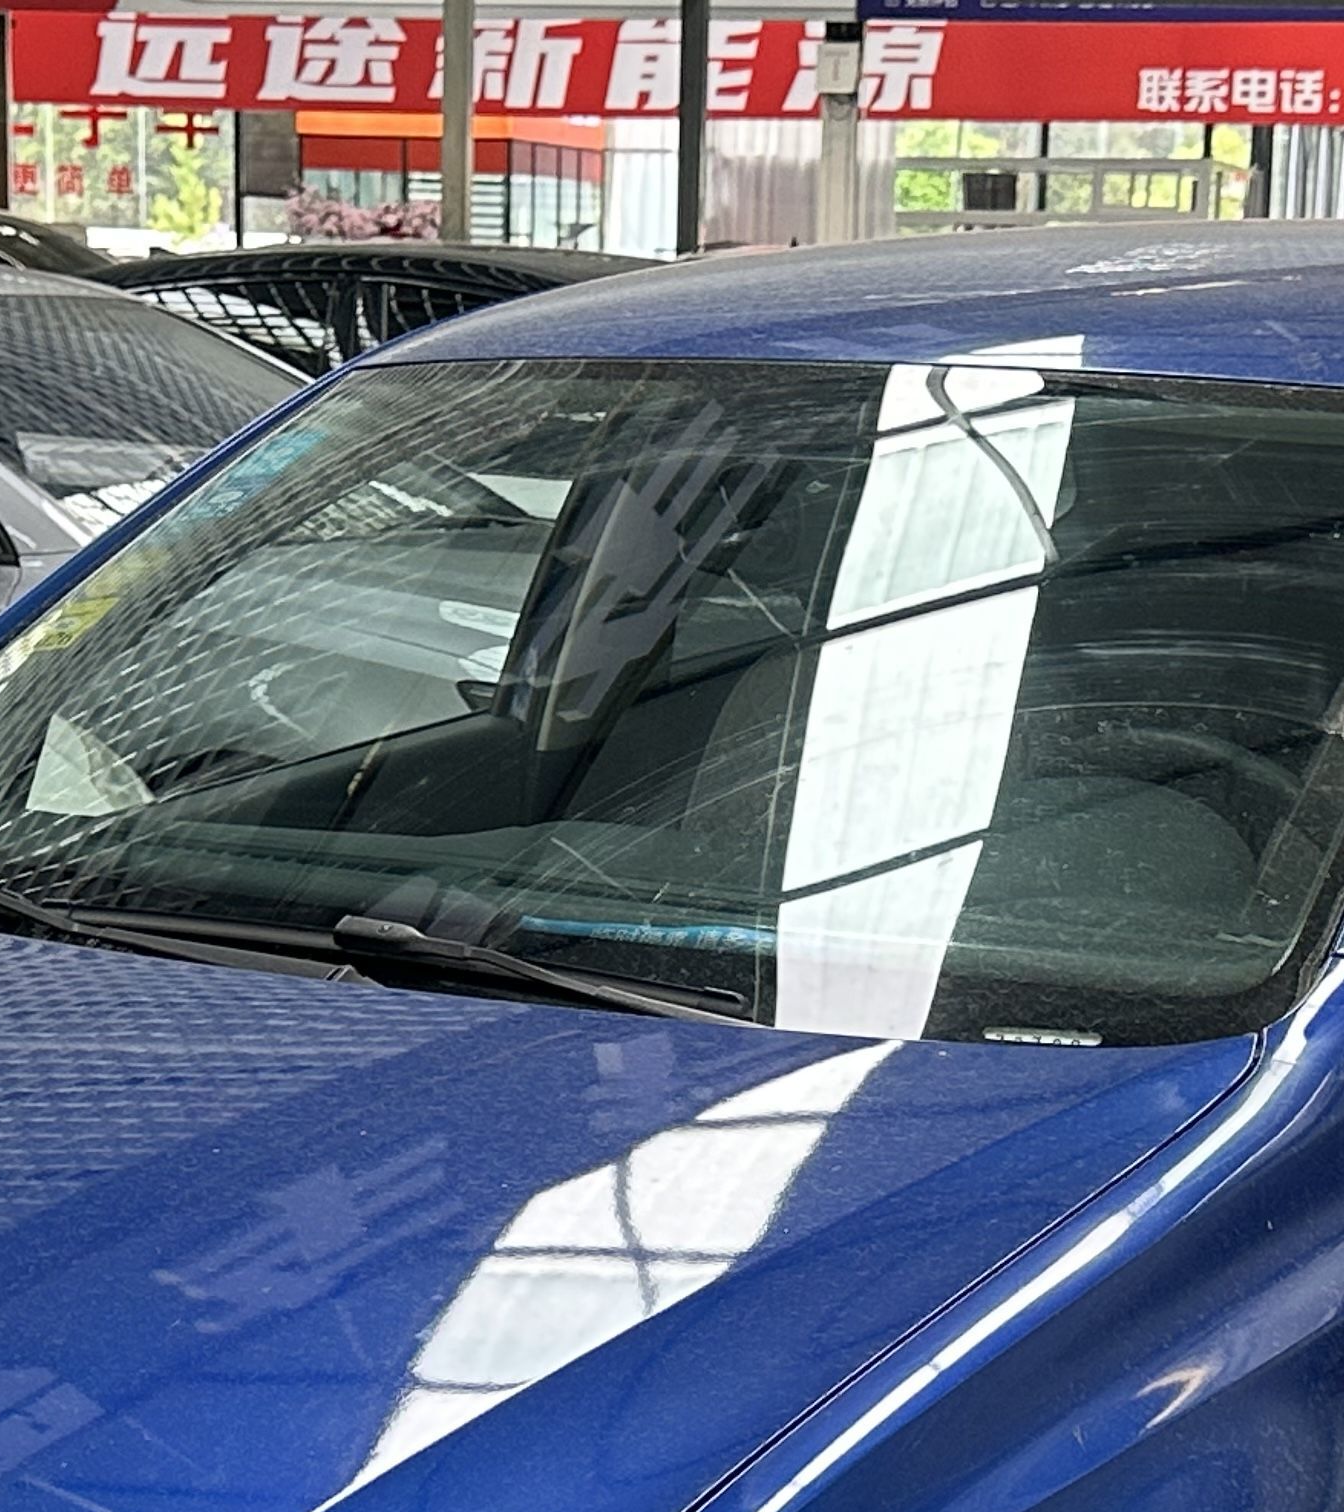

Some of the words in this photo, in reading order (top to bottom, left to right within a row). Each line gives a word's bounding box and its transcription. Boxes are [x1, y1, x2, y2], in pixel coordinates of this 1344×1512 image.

[88, 12, 946, 112] 远途新能源
